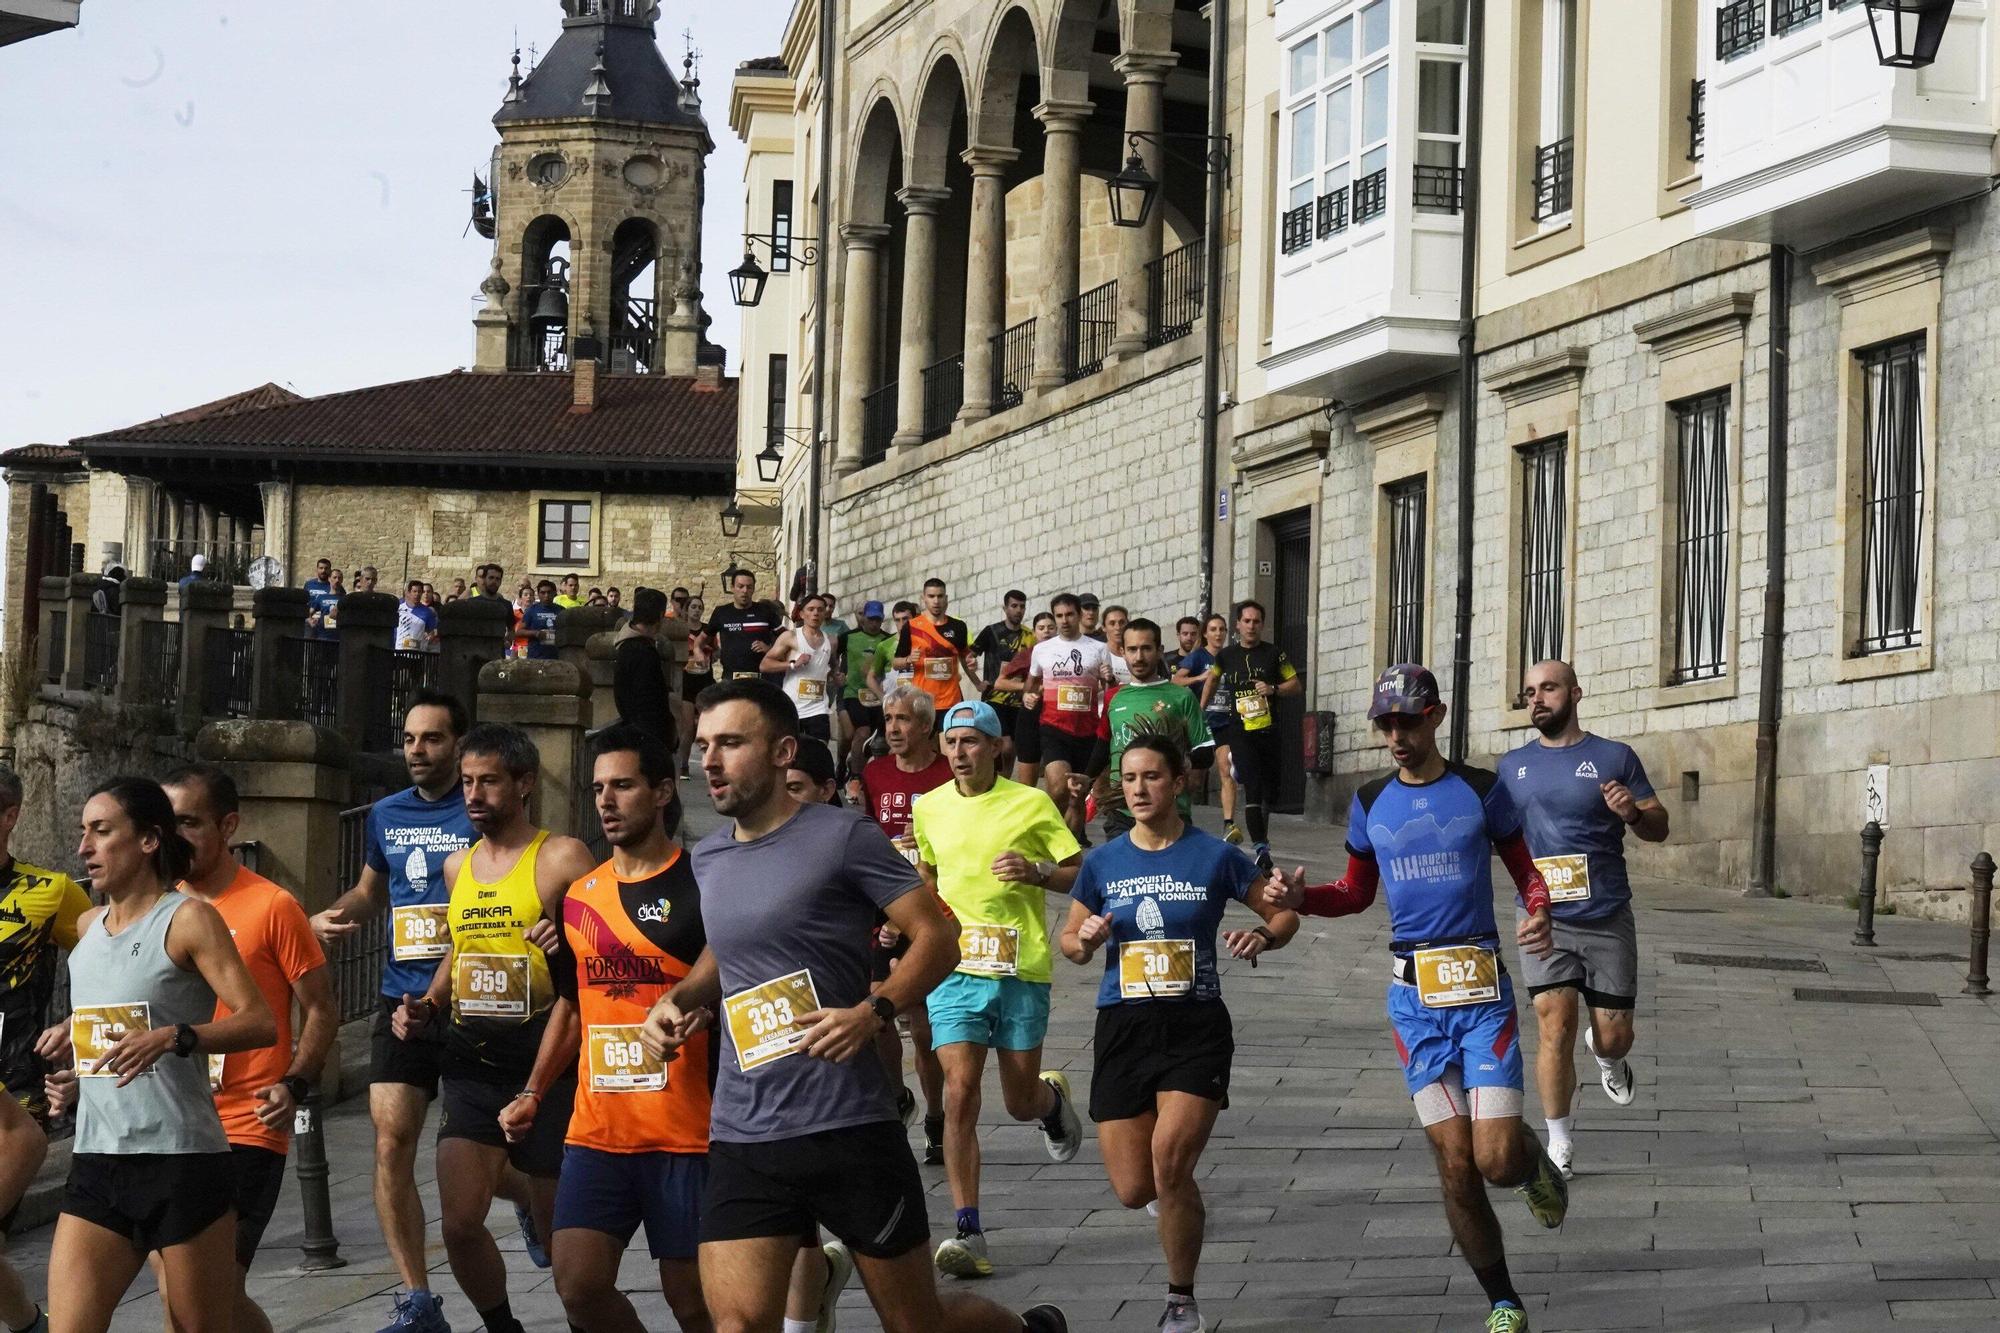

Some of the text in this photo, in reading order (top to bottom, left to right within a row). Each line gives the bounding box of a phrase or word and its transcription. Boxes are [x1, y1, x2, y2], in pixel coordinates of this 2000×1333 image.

[1379, 680, 1404, 693] UTMB
[385, 827, 442, 836] LA CONQUISTA
[395, 834, 457, 845] ALMENDRA
[1107, 874, 1173, 889] LA CONQUISTA
[1544, 867, 1573, 885] 399
[1119, 881, 1194, 898] ALMENDRA
[1159, 892, 1208, 901] KONKISTA
[462, 906, 512, 920] GAIKAR
[405, 918, 437, 940] 393
[969, 936, 1000, 956] 319
[585, 957, 663, 979] FORONDA
[1144, 954, 1169, 975] 30
[1437, 960, 1478, 985] 652
[470, 970, 508, 993] 359
[792, 979, 805, 989] 10K
[748, 997, 794, 1036] 333
[604, 1042, 643, 1067] 659
